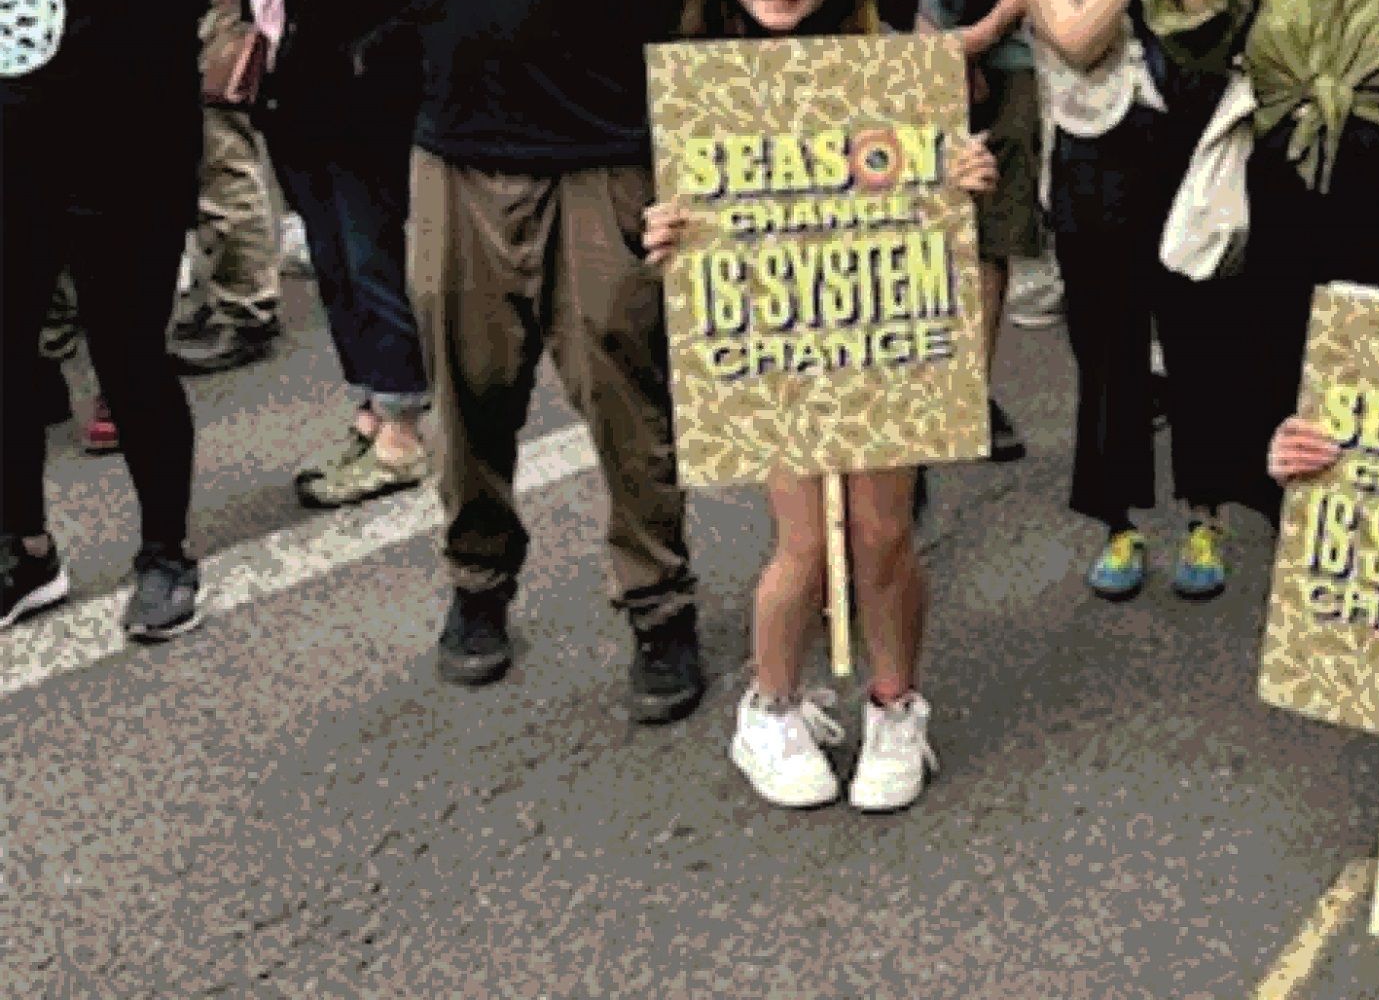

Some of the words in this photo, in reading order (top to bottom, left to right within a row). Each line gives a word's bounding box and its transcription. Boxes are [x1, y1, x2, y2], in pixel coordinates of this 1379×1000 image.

[721, 197, 922, 235] CHANGE
[690, 249, 744, 334] IS
[758, 230, 954, 329] SYSTEM
[705, 322, 954, 379] CHANGE
[1306, 489, 1356, 578] IS
